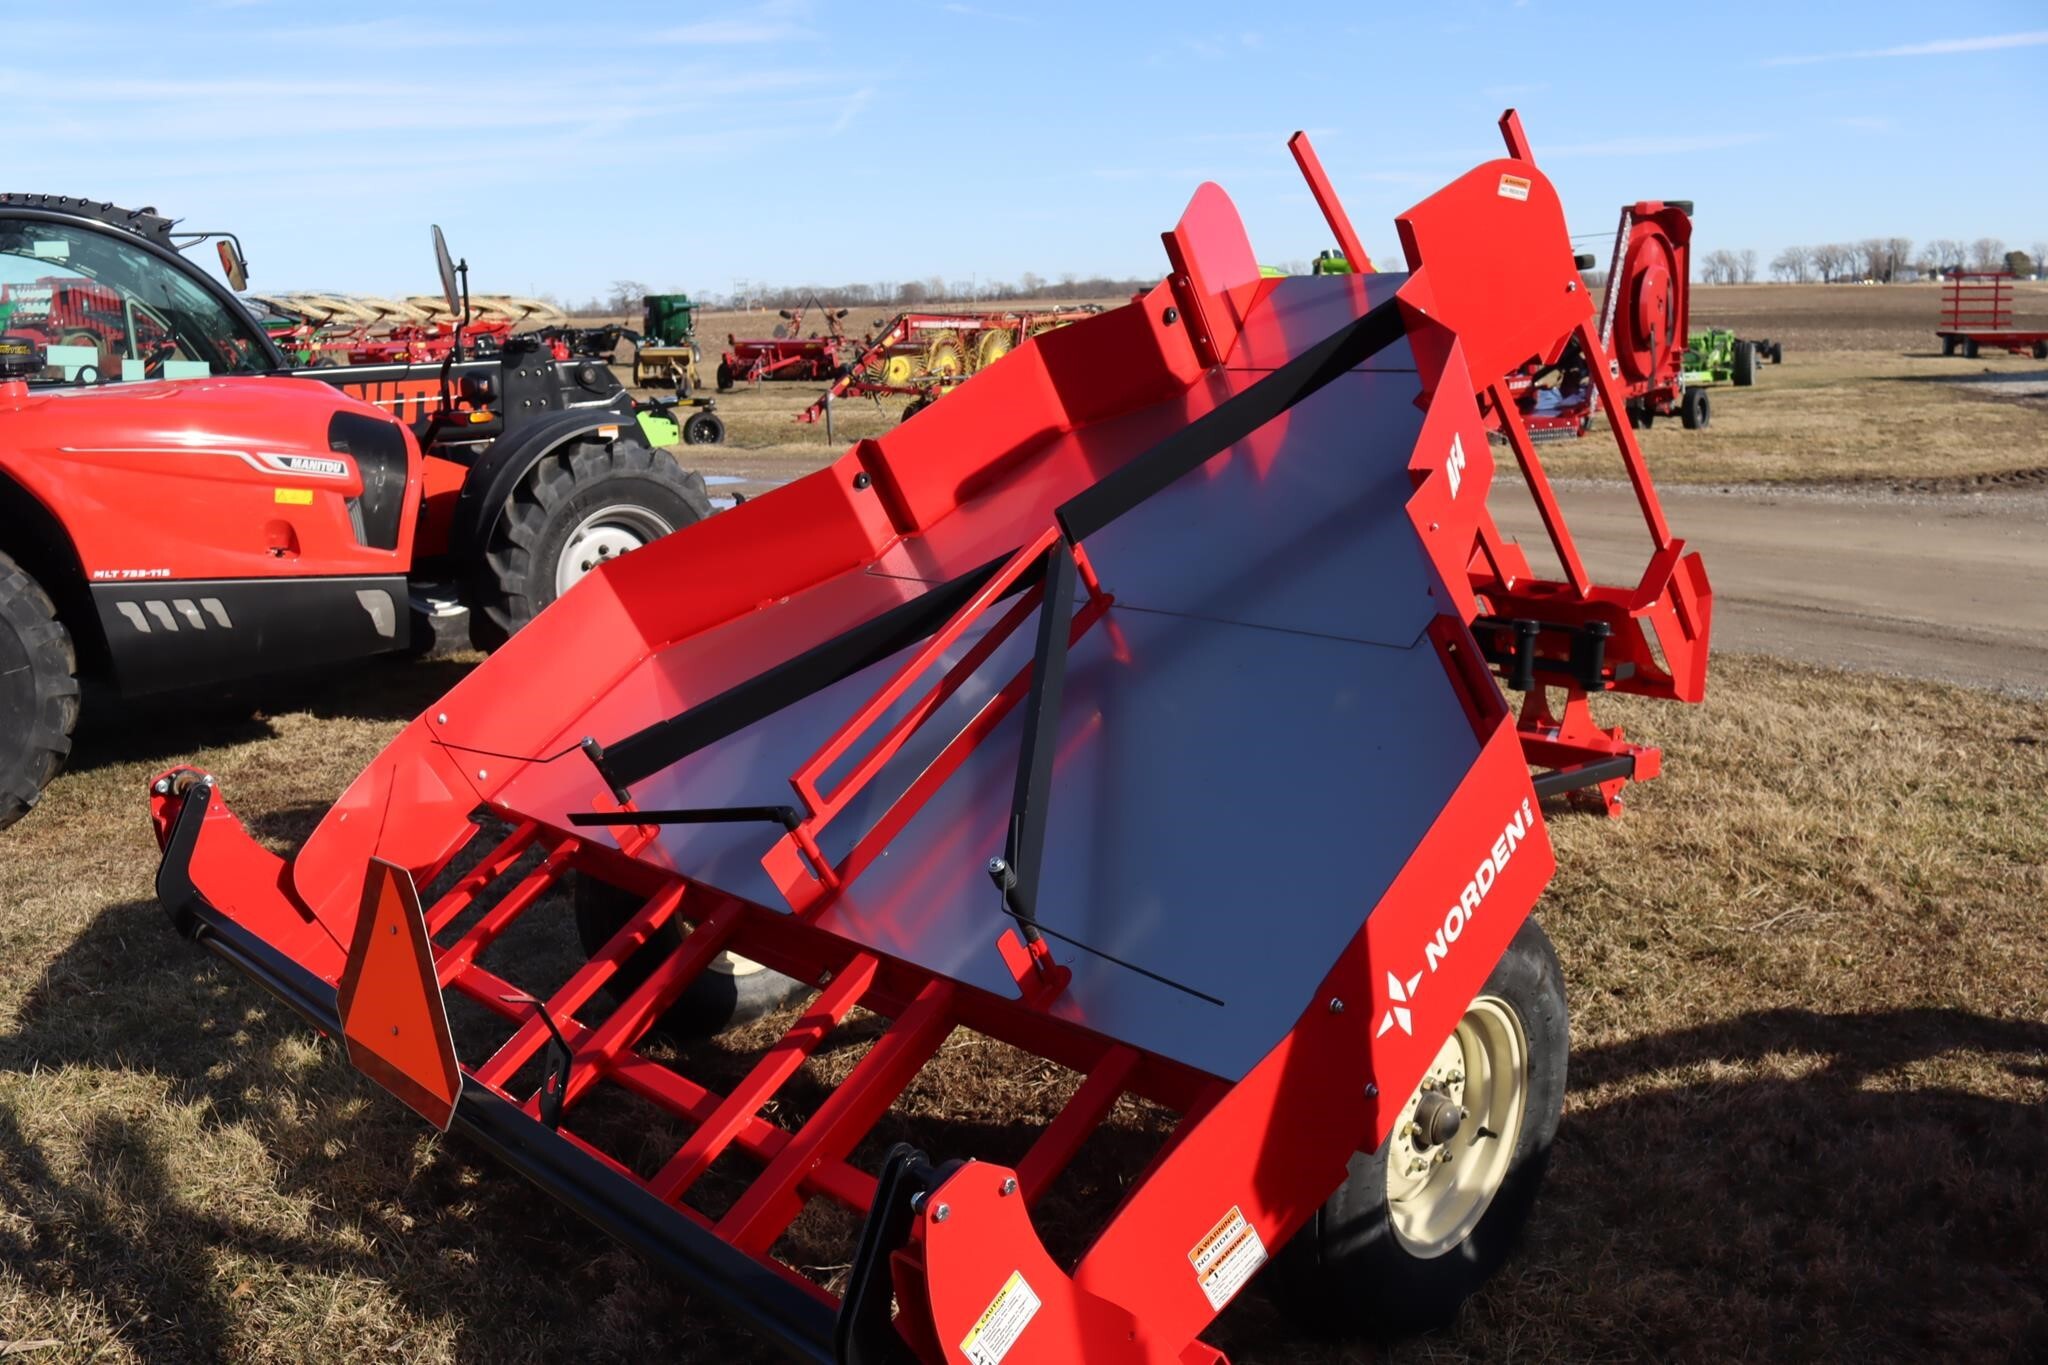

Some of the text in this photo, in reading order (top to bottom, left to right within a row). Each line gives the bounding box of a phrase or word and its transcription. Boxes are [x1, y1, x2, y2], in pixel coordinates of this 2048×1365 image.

[291, 457, 341, 473] MANITOU
[93, 569, 120, 579] MLT
[1424, 809, 1526, 974] NORDEN
[1197, 1254, 1211, 1268] NO
[1211, 1220, 1242, 1254] RIDERS
[1203, 1213, 1237, 1249] WARNING
[1215, 1233, 1247, 1267] WARNING
[981, 1290, 1007, 1324] CAUTION
